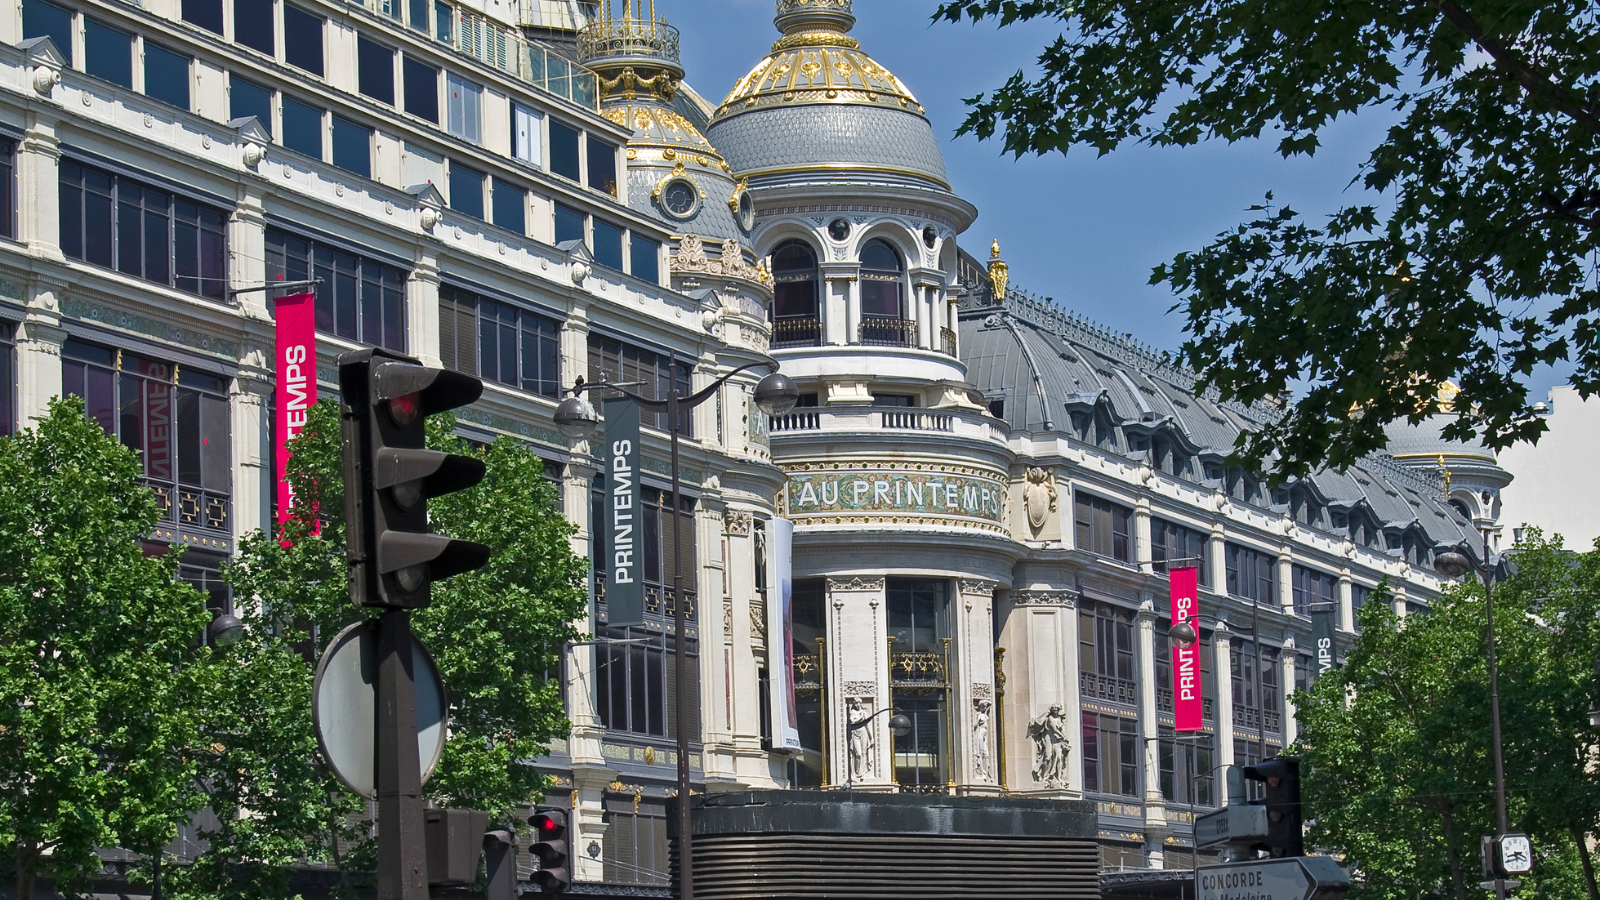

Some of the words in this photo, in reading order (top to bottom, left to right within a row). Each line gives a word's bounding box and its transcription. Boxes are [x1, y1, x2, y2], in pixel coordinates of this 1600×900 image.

[286, 345, 308, 514] TEMPS
[613, 439, 633, 584] PRINTEMPS
[798, 481, 838, 507] AU
[853, 480, 998, 514] PRINTEMPS
[1177, 597, 1194, 700] PRINTPS
[1202, 871, 1263, 890] CONCORDE
